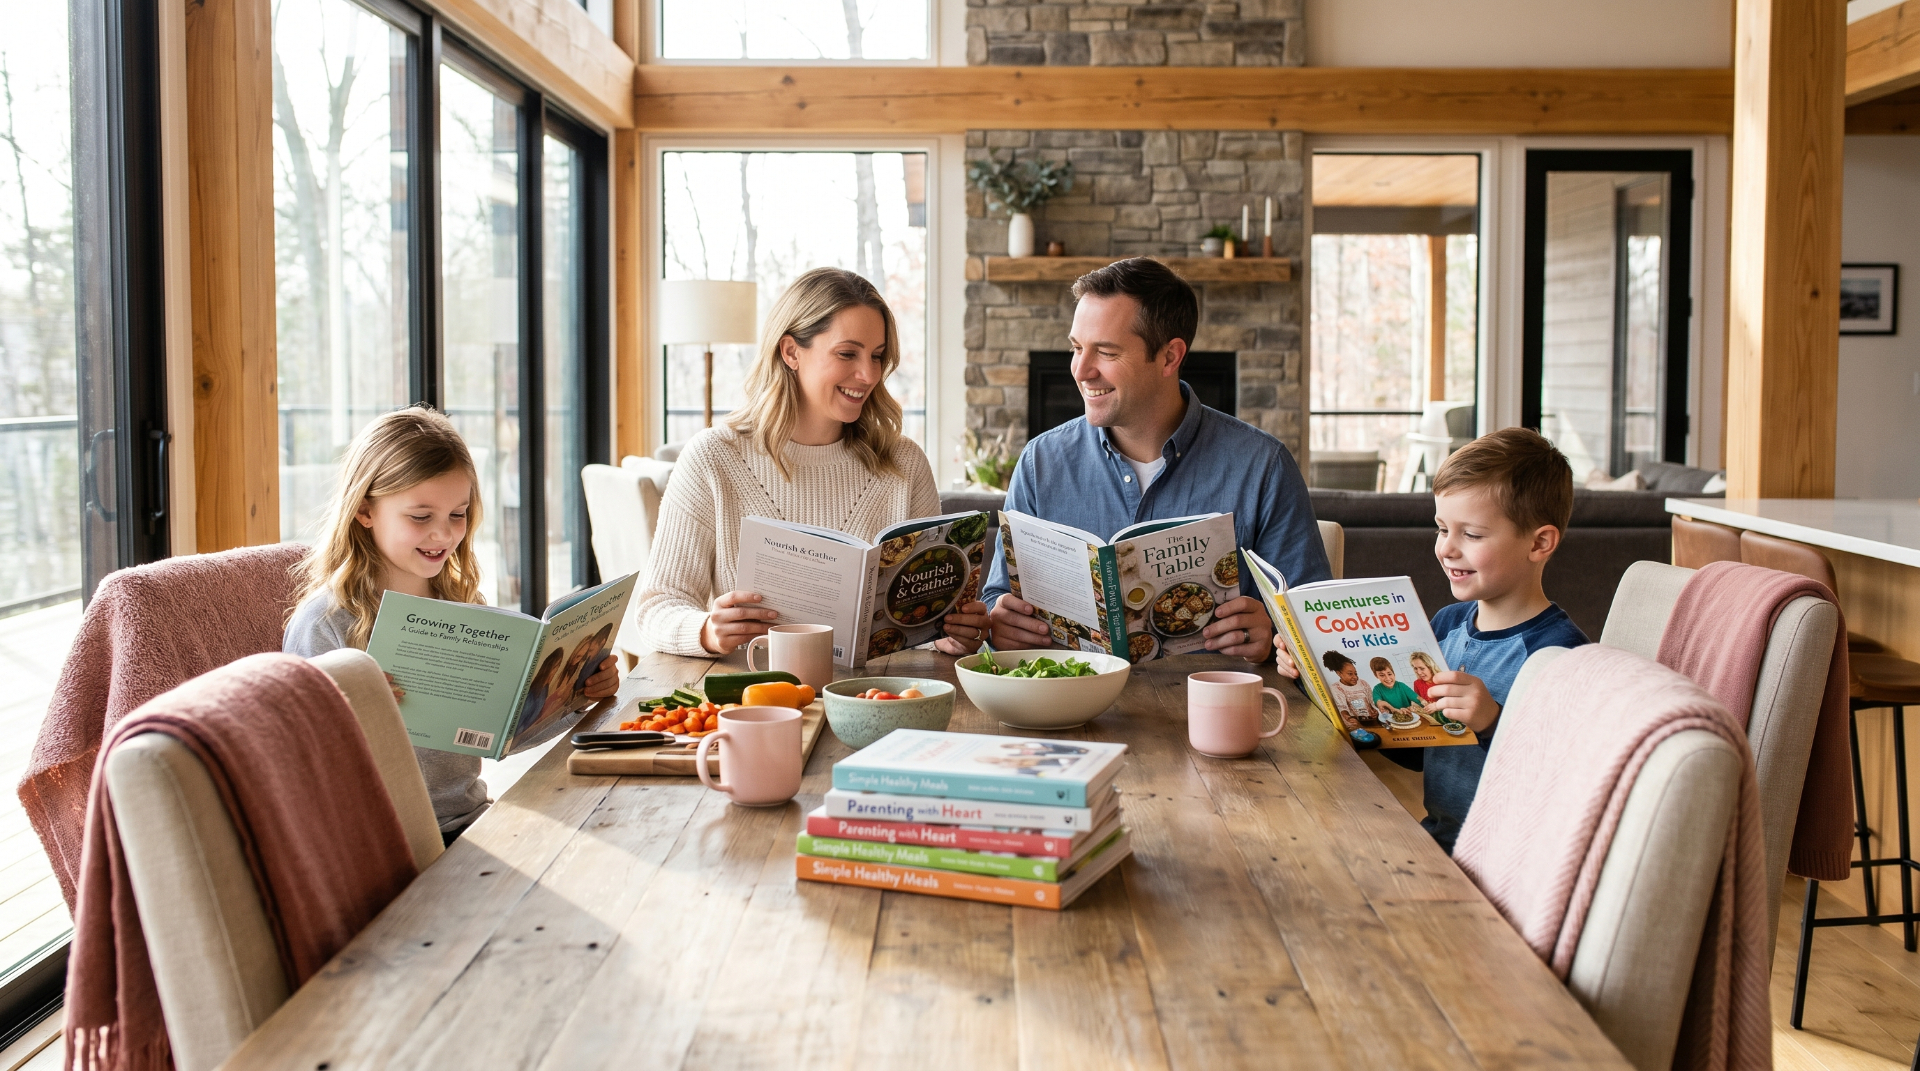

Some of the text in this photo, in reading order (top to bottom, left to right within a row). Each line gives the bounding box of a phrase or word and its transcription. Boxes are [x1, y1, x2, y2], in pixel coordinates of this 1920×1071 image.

[764, 537, 798, 553] Nourish
[799, 547, 807, 555] &
[808, 549, 838, 562] Gather
[1143, 536, 1211, 564] Family
[1166, 536, 1184, 544] The
[900, 562, 954, 587] Nourish
[1150, 555, 1206, 578] Table
[896, 587, 908, 599] &
[910, 574, 957, 594] Gather
[1304, 592, 1406, 613] Adventures in
[406, 613, 511, 642] Growing Together
[408, 626, 429, 636] Guide
[551, 611, 589, 636] Growing
[1315, 611, 1410, 634] Cooking
[1341, 632, 1399, 649] for Kids
[848, 772, 949, 791] Simple Healthy Meals
[847, 799, 914, 822] Parenting
[917, 803, 939, 815] with
[941, 804, 982, 819] Heart
[838, 821, 896, 843] Parenting
[920, 827, 956, 844] Heart
[852, 843, 895, 863] Healthy
[896, 850, 929, 864] Meals
[812, 861, 852, 880] Simple
[854, 865, 901, 888] Healthy
[903, 871, 939, 889] Meals
